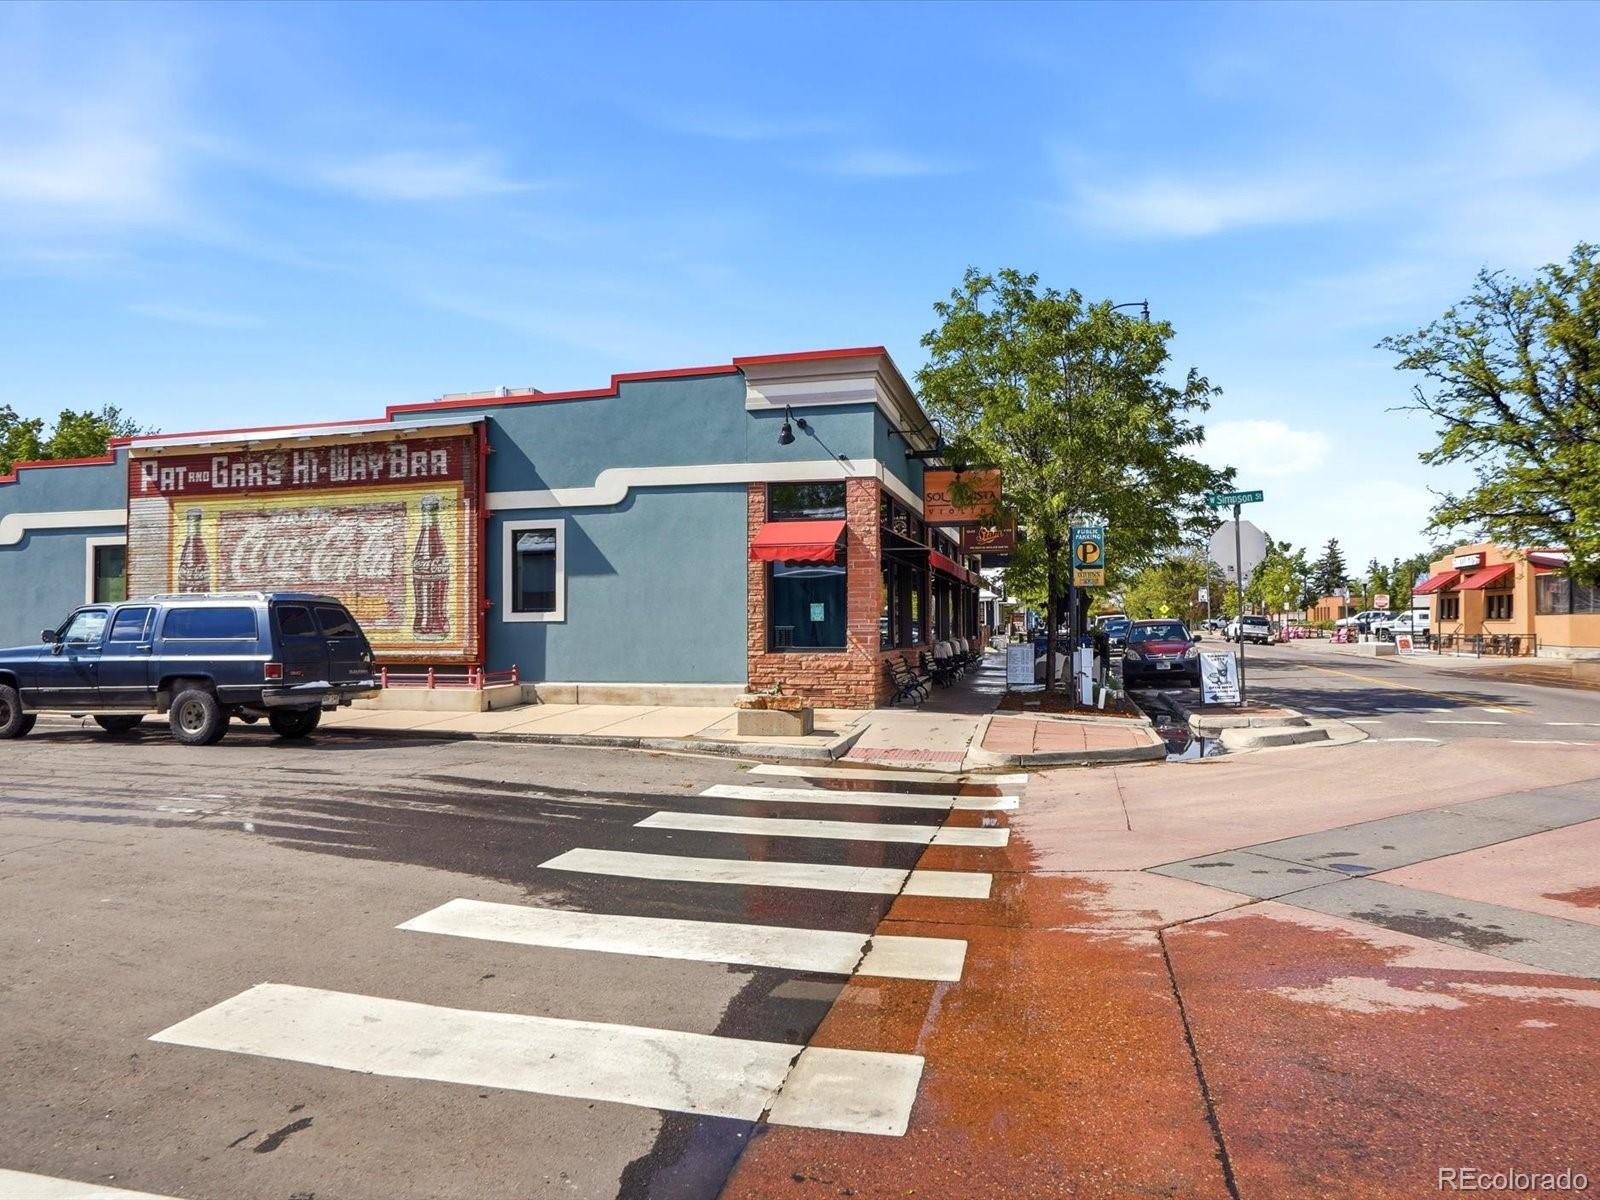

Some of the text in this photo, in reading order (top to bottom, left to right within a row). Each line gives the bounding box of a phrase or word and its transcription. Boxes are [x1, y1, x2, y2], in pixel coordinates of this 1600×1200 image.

[141, 461, 187, 491] PAT
[188, 471, 210, 482] AND
[1216, 494, 1253, 505] Simpson
